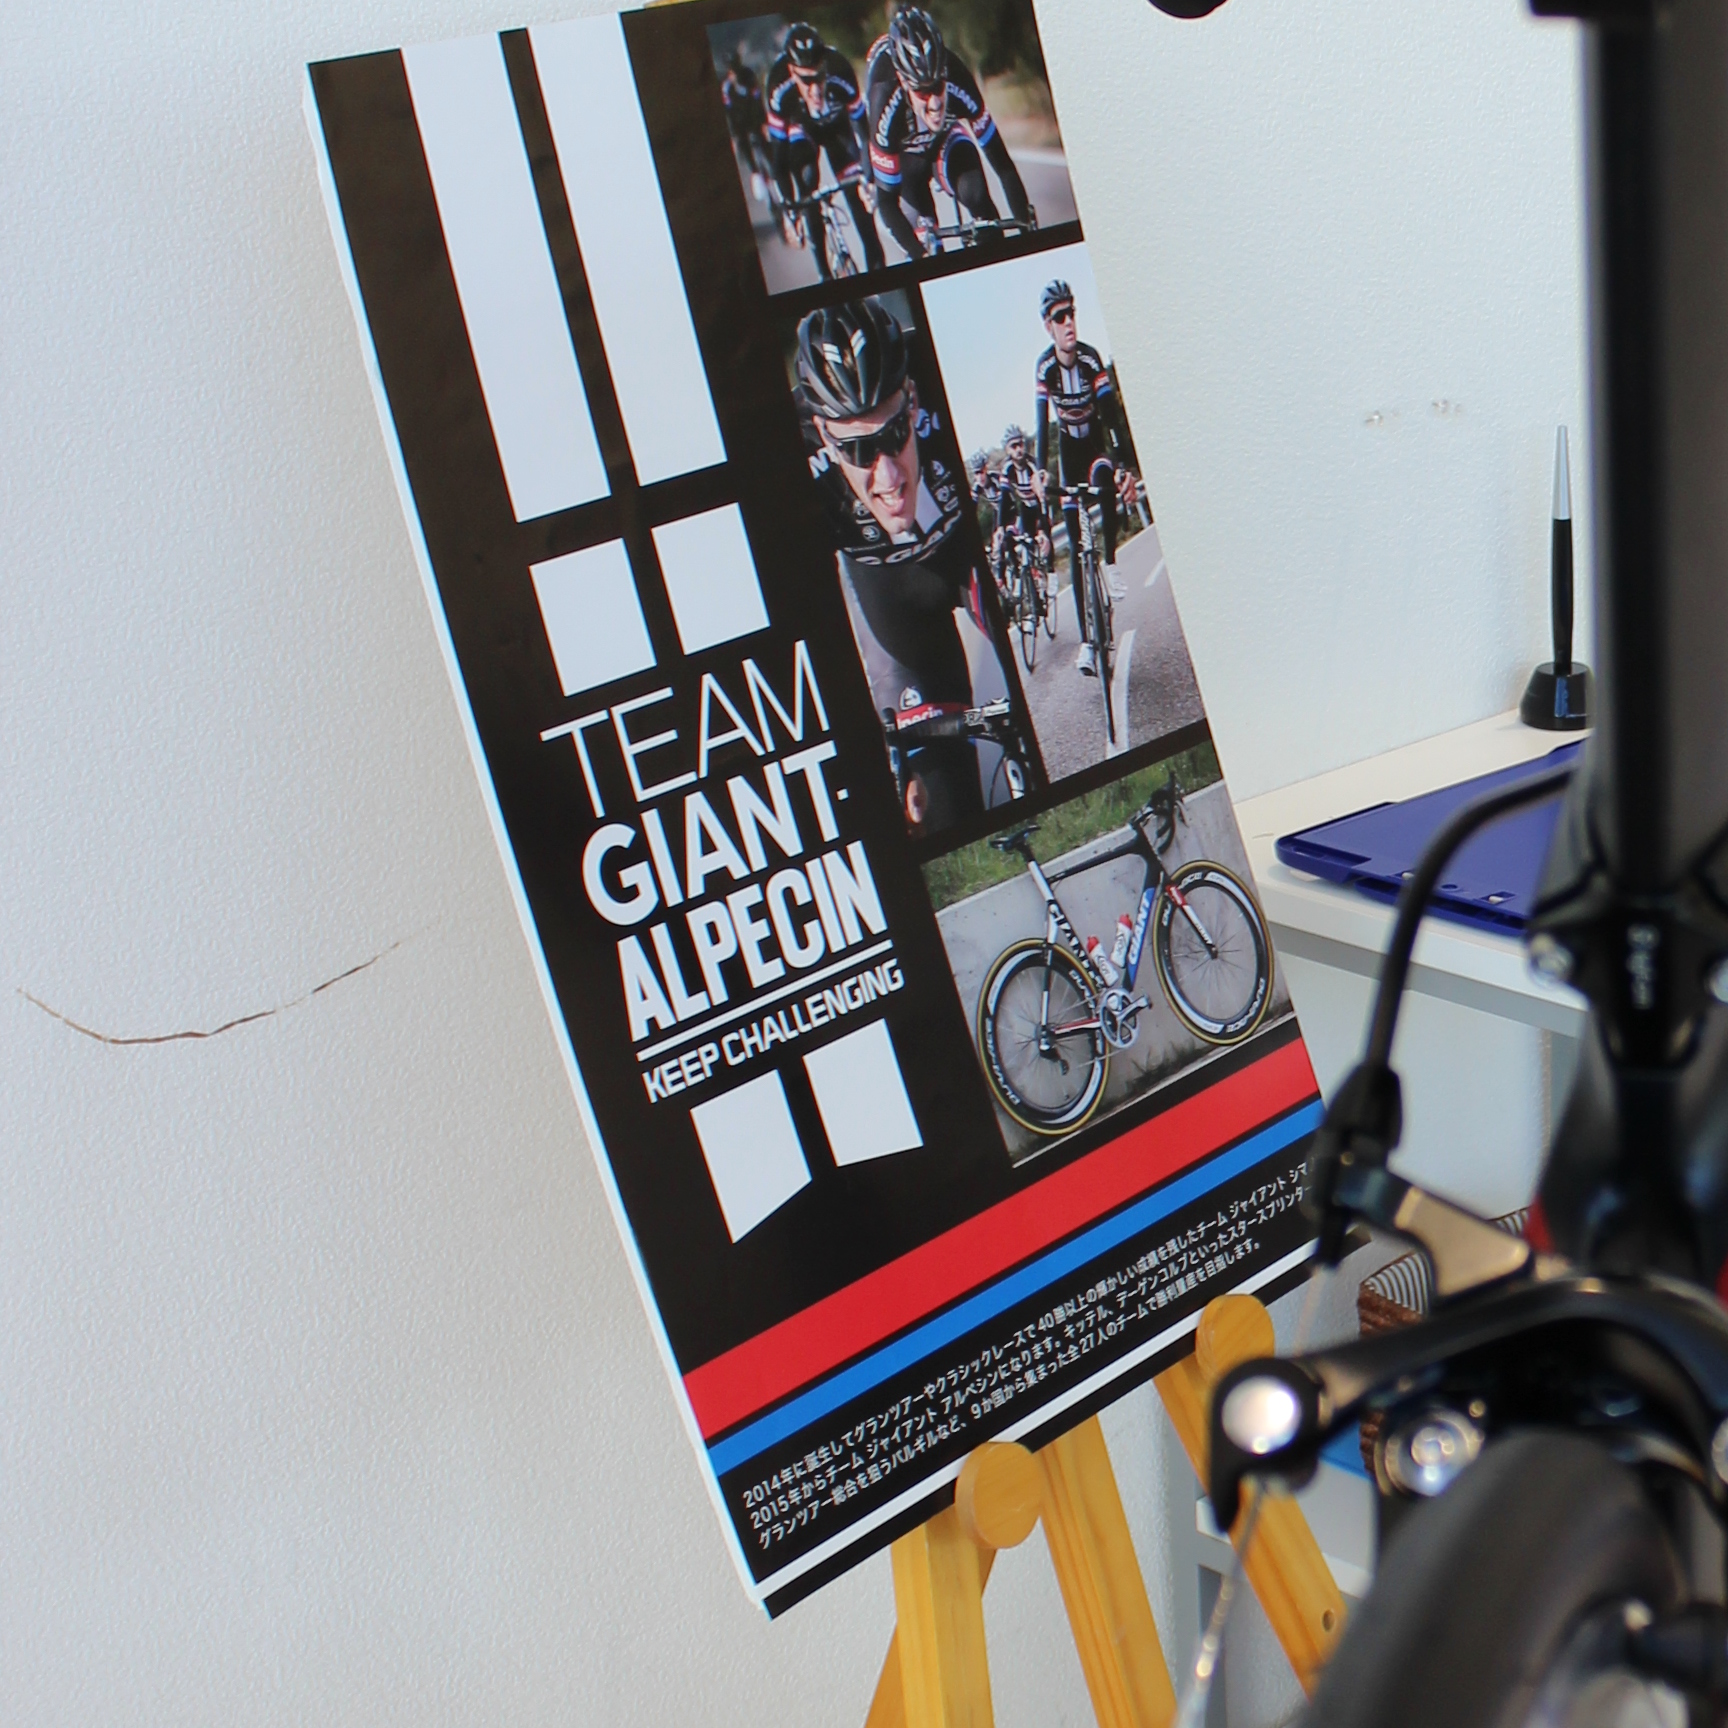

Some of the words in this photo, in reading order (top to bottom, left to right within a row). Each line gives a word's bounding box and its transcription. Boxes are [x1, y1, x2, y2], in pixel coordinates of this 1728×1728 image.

[540, 639, 831, 819] TEAM
[616, 840, 889, 1043] ALPECIN
[641, 1041, 720, 1104] KEEP
[725, 956, 905, 1069] CHALLENGING
